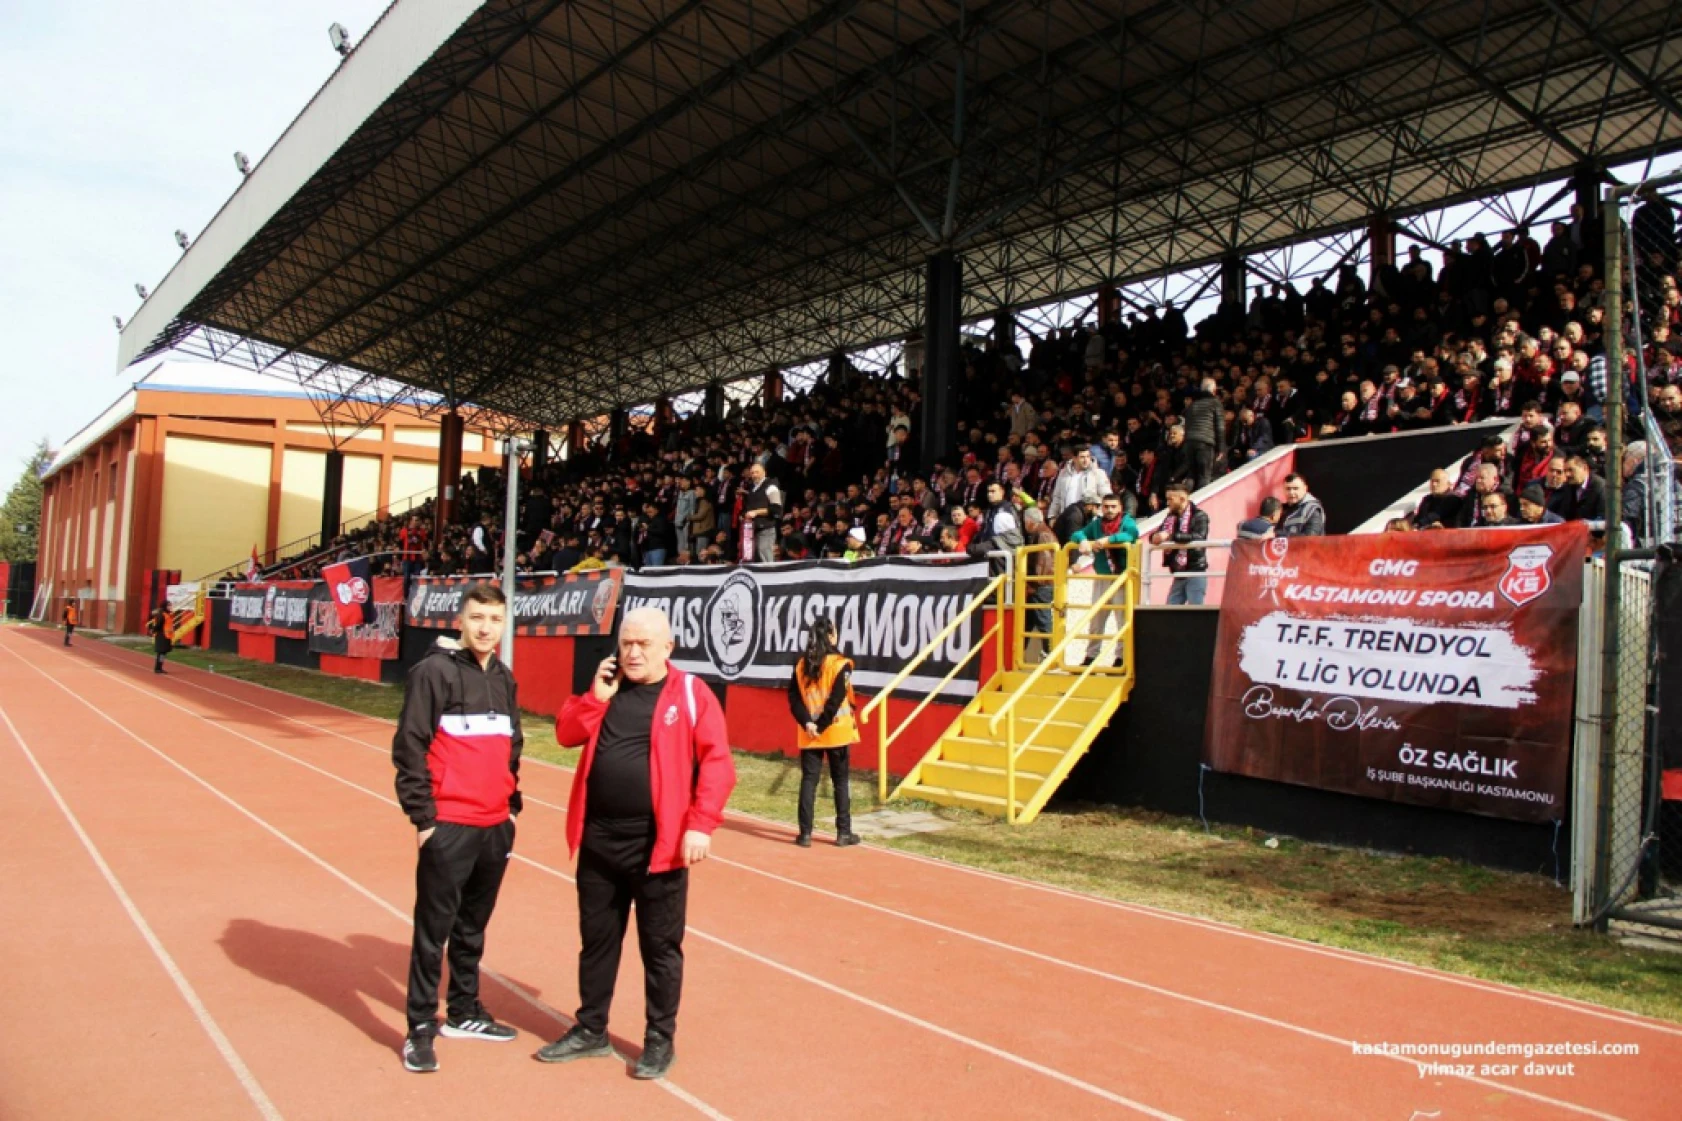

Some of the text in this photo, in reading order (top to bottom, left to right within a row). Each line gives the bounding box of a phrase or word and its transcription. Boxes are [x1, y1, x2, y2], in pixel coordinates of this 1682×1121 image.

[1249, 564, 1299, 578] trendyol
[1369, 558, 1419, 577] GMG
[1283, 584, 1495, 609] KASTAMONU SPORA
[1277, 623, 1492, 658] T.F.F. TRENDYOL
[1276, 657, 1482, 698] 1. LİG YOLUNDA
[1399, 743, 1518, 779] ÖZ SAĞLIK
[1406, 773, 1474, 793] BAŞKANLIĞI
[1477, 784, 1555, 805] KASTAMONU
